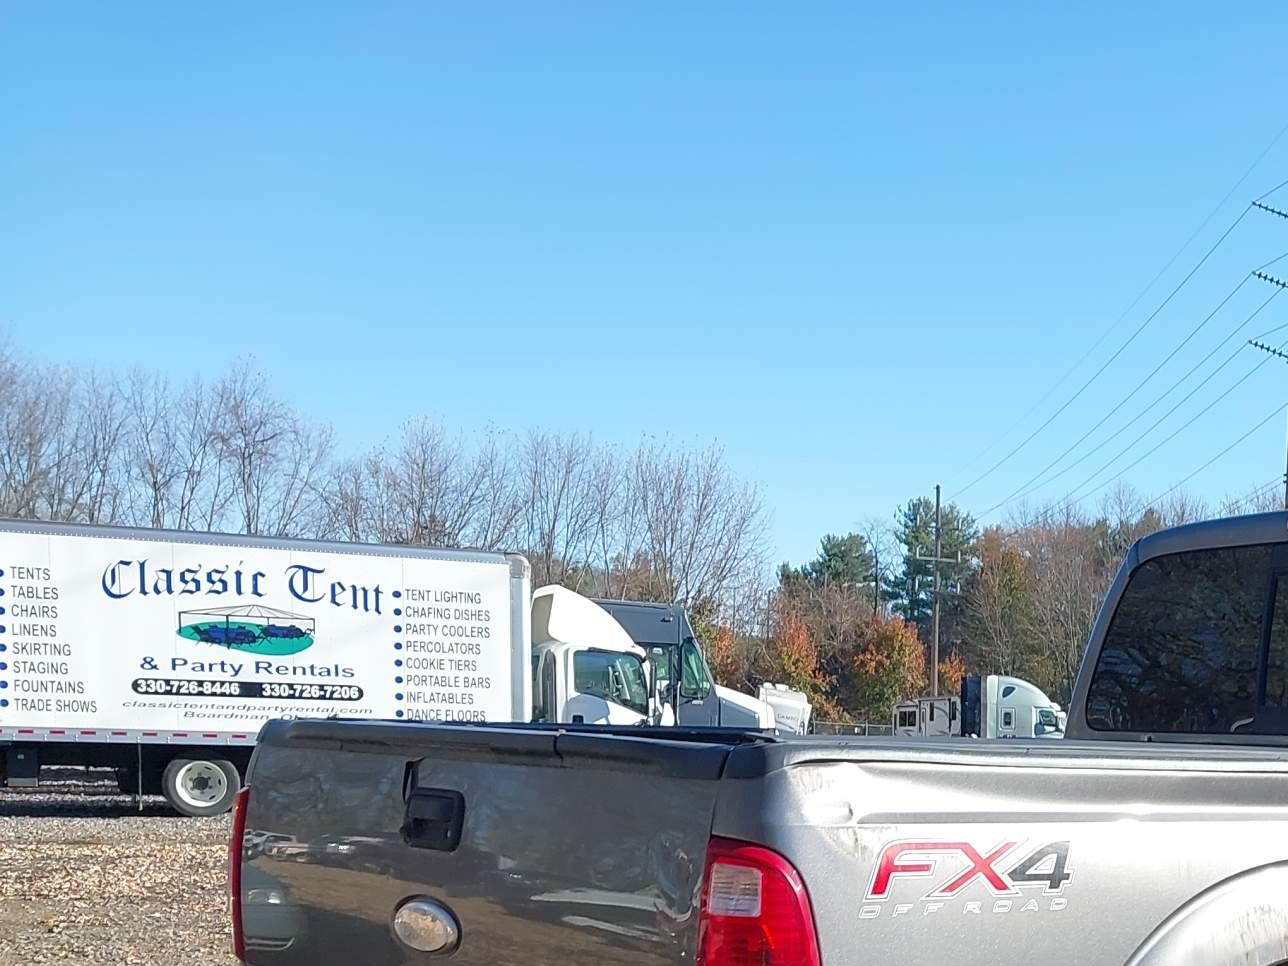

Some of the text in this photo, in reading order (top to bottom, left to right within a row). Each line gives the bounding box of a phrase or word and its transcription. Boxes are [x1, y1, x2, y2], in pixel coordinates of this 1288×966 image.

[10, 566, 51, 581] TENTS
[10, 585, 59, 600] TABLES
[101, 559, 384, 615] Classic Tent
[405, 588, 481, 605] TENT LIGHTING
[11, 604, 58, 619] CHAIRS
[405, 606, 491, 622] CHAFING DISHES
[11, 623, 57, 637] LINENS
[405, 623, 491, 639] PARTY COOLERS
[12, 642, 72, 656] SKIRTING
[406, 641, 481, 655] PERCOLATORS
[13, 660, 69, 675] STAGING
[139, 656, 356, 678] & Party Rentals
[406, 657, 477, 672] COOKIE TIERS
[13, 679, 85, 694] FOUNTAINS
[136, 679, 240, 696] 330-726-8446
[406, 674, 491, 689] PORTABLE BARS
[261, 682, 359, 699] 330-726-7206
[406, 691, 474, 704] INFLATABLES
[14, 698, 98, 713] TRADE SHOWS
[407, 708, 487, 721] DANCE FLOORS
[865, 839, 1076, 901] FX4
[858, 897, 1068, 919] OFF ROAD
